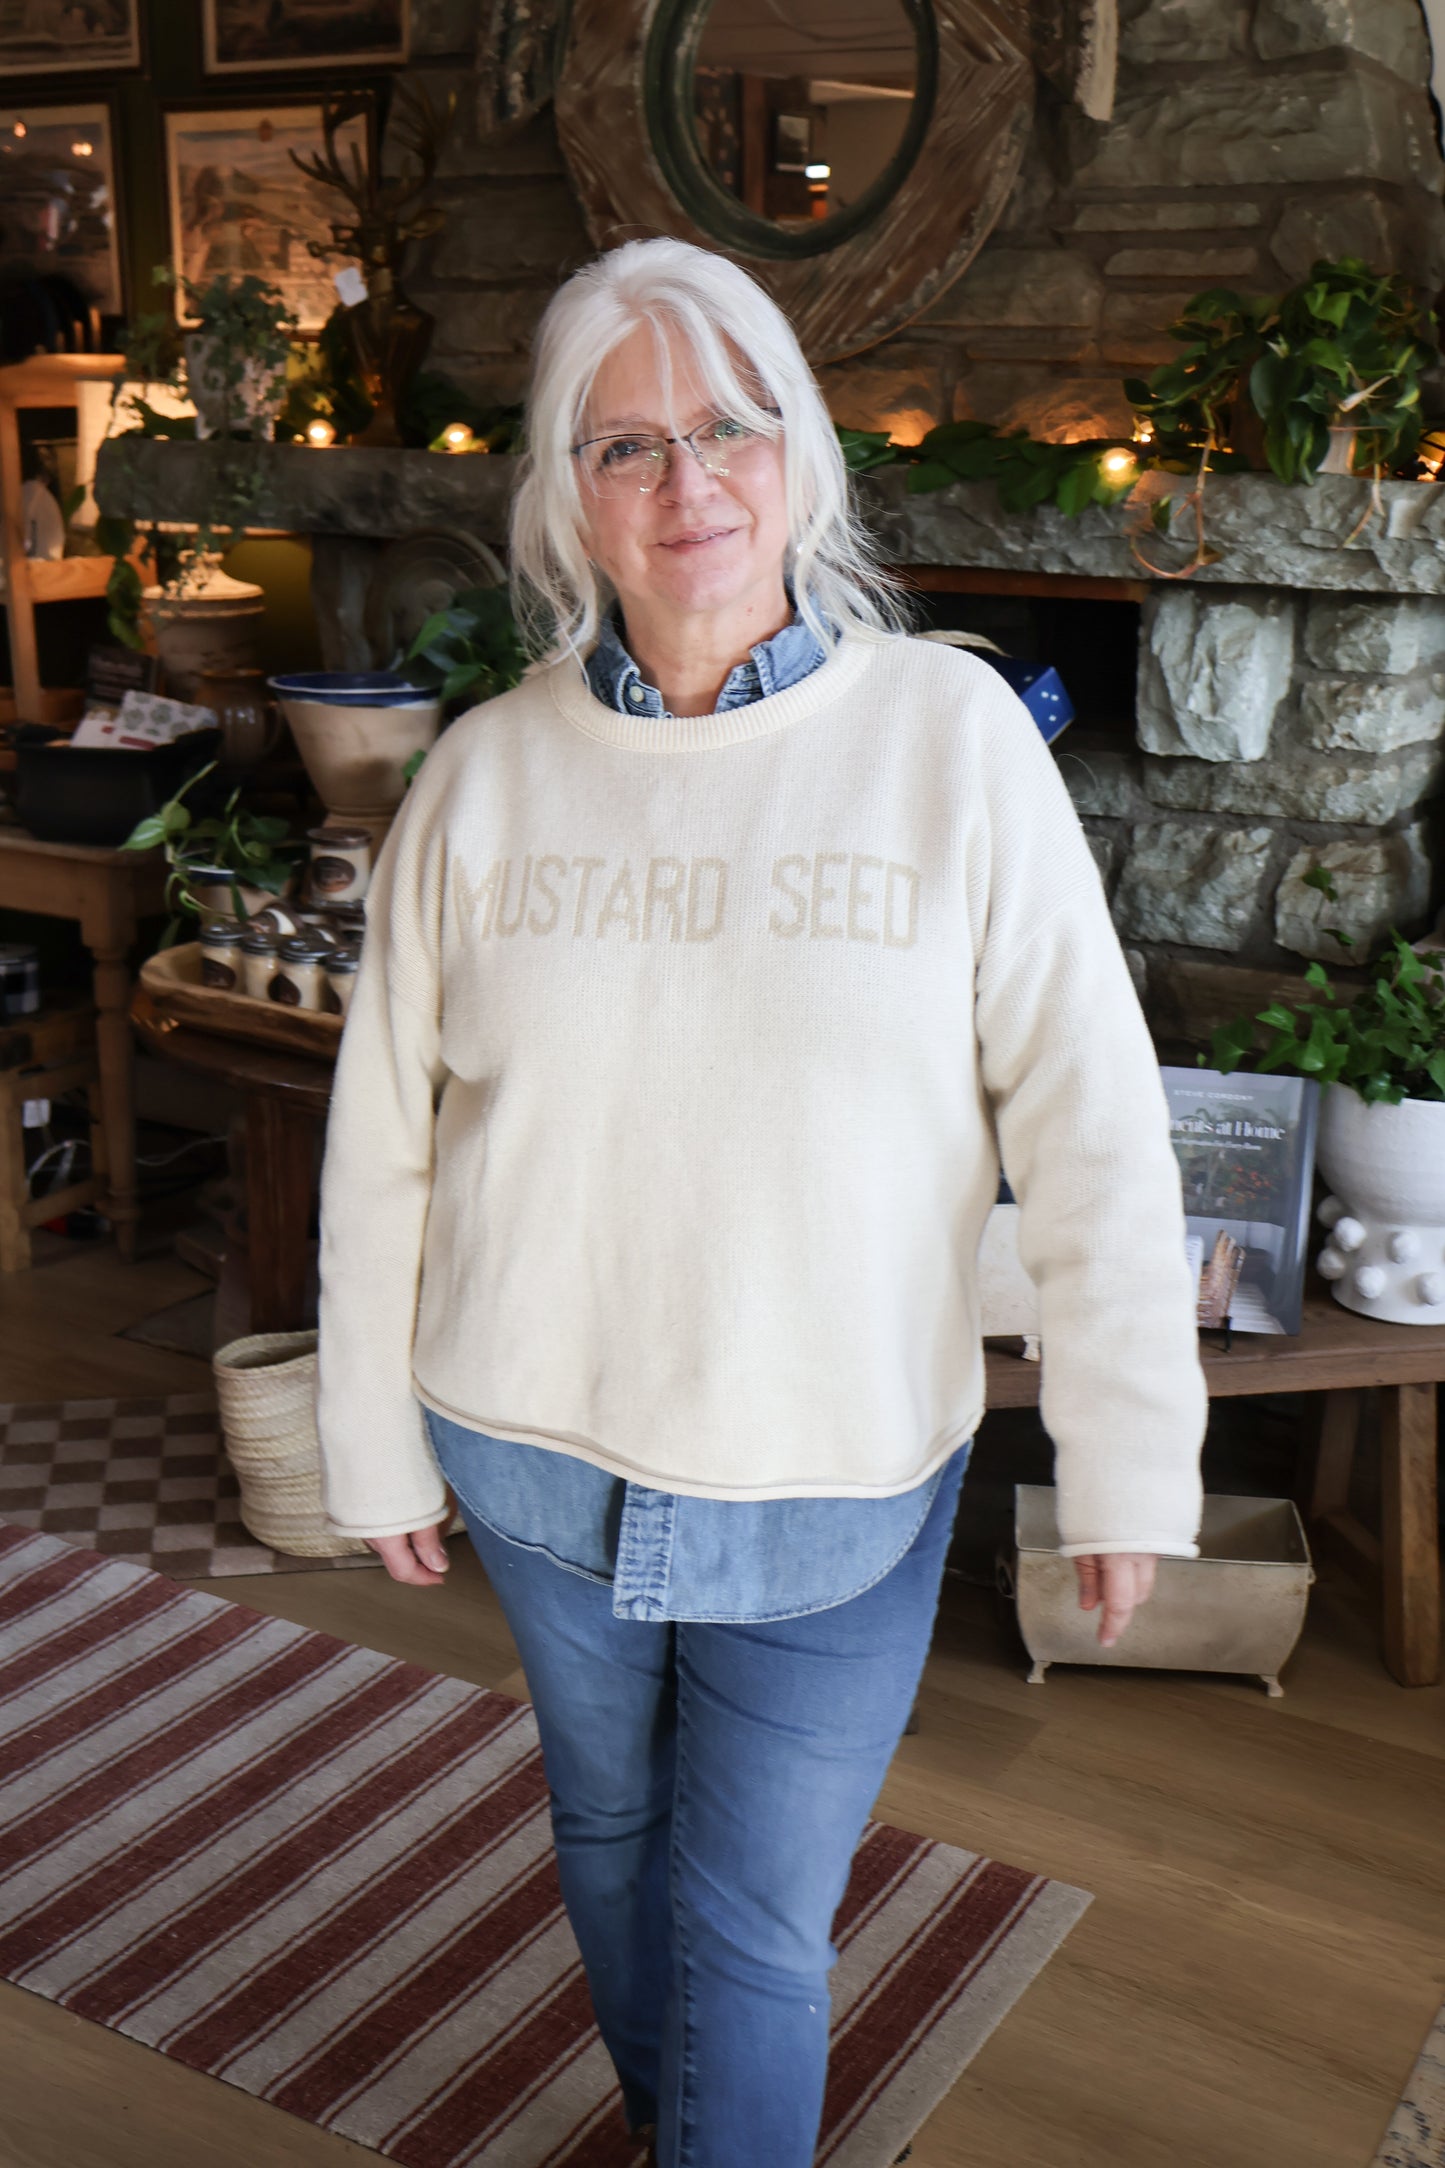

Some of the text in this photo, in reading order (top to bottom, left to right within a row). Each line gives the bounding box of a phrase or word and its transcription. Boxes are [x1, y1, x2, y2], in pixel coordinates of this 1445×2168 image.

[452, 852, 922, 949] MUSTARD SEED
[1215, 1121, 1233, 1136] at
[1234, 1120, 1287, 1140] Home
